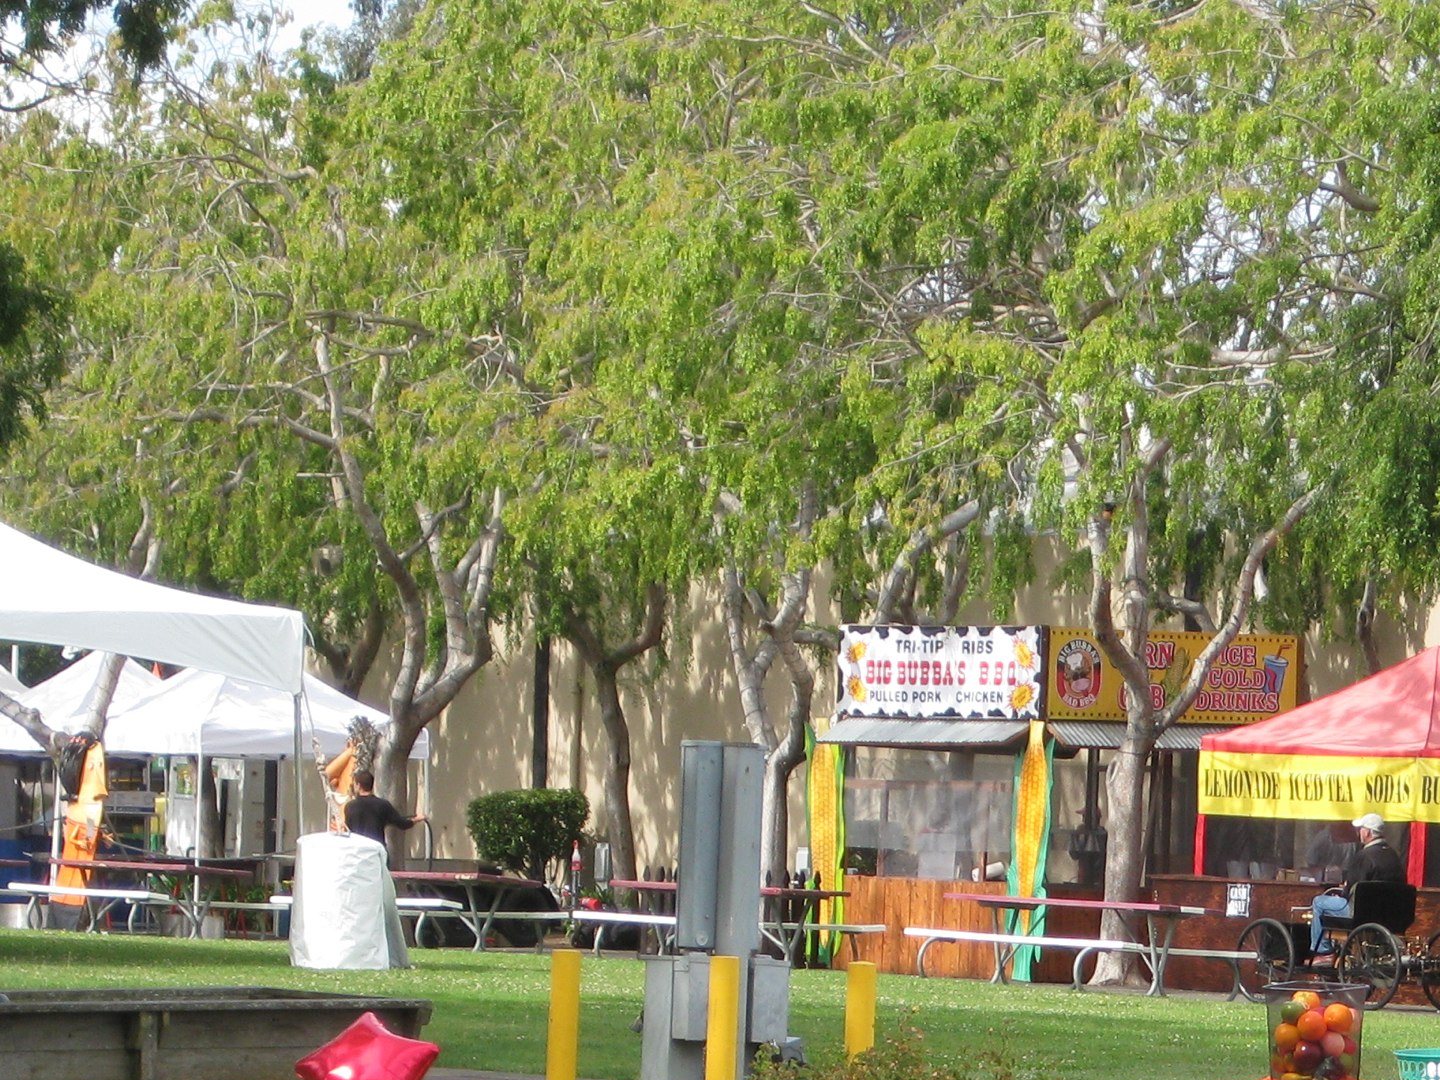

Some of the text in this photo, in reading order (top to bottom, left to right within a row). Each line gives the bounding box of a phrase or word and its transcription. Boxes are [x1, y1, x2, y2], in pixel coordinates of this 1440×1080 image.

[896, 639, 993, 654] TRI-TIP RIBS
[1220, 645, 1256, 666] ICE
[866, 660, 892, 684] BIG
[897, 660, 966, 686] BUBBA'S
[1208, 668, 1267, 689] COLD
[870, 690, 1003, 703] PULLED PORK CHICKEN
[1194, 691, 1279, 712] DRINKS
[1204, 769, 1281, 800] LEMONADE
[1289, 772, 1324, 801] ICED
[1325, 773, 1353, 802] TEA
[1364, 774, 1411, 804] SODAS
